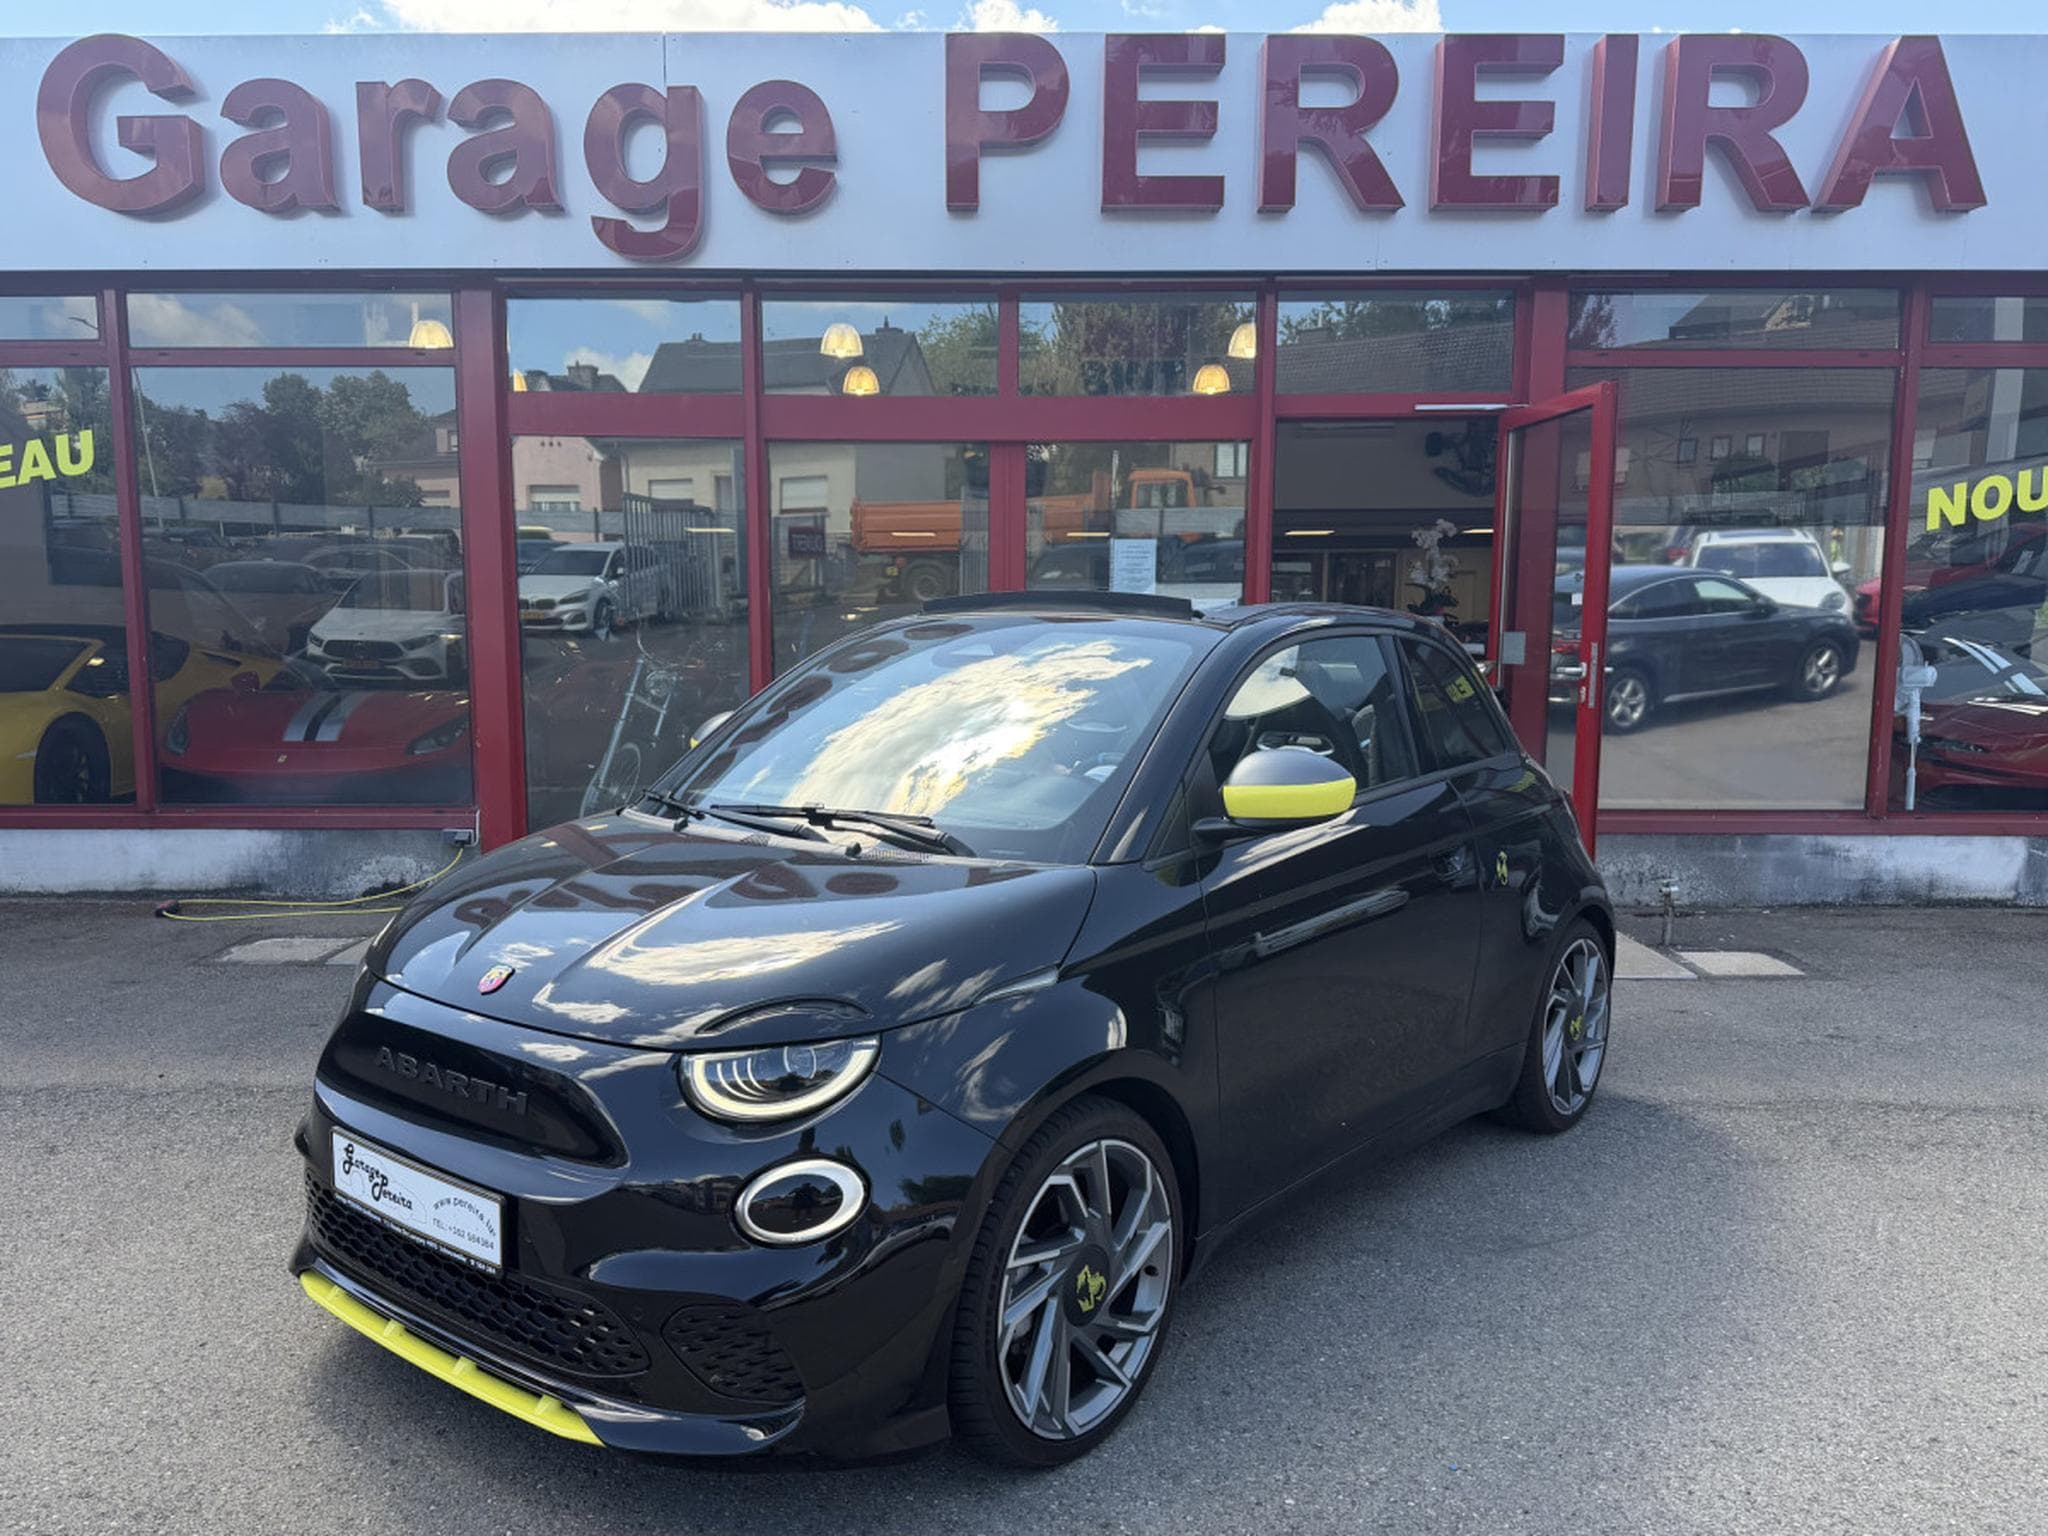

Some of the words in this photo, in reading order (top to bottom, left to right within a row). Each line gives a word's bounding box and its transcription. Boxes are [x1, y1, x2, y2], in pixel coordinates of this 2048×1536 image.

[36, 33, 837, 263] Garage
[945, 33, 1988, 213] PEREIRA
[376, 1046, 528, 1116] ABARTH
[342, 1143, 380, 1182] Garage
[371, 1173, 413, 1211] Pereira
